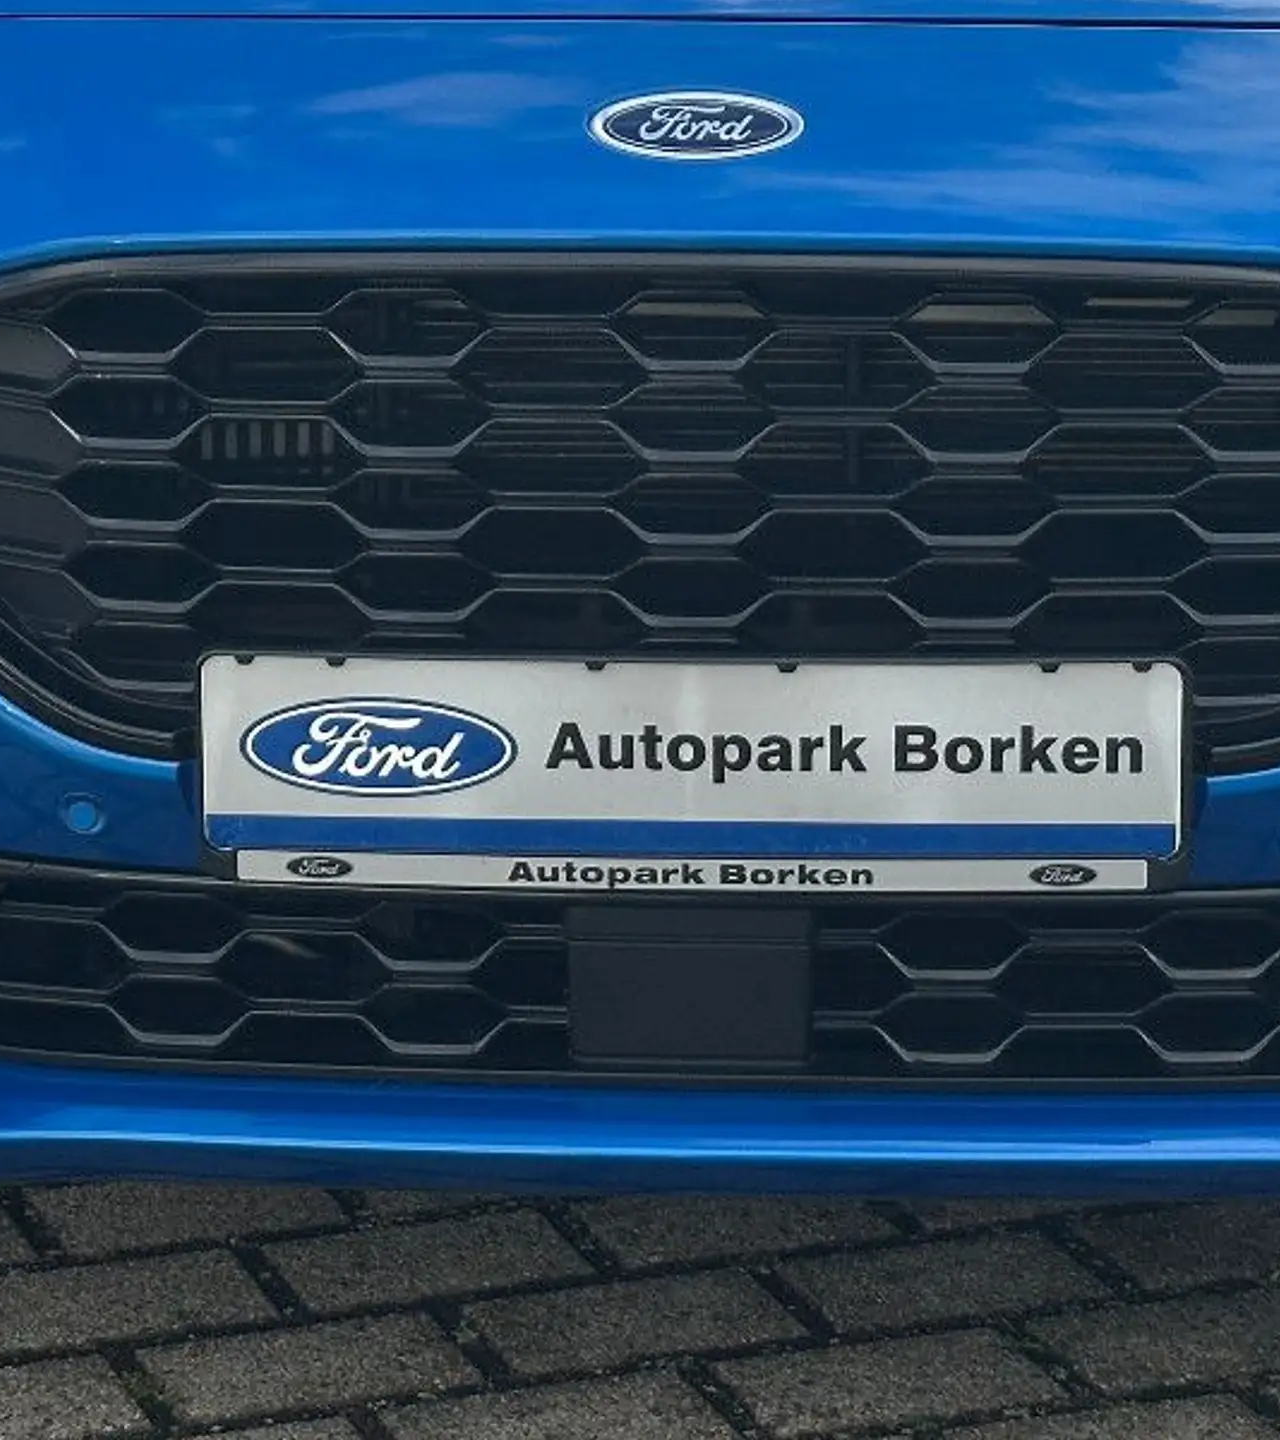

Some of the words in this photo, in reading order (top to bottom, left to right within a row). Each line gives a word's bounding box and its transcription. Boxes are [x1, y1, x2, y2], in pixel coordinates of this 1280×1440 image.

[639, 105, 754, 141] Ford
[292, 711, 465, 779] Ford
[545, 722, 868, 784] Autopark
[894, 724, 1144, 775] Borken
[508, 860, 705, 889] Autopark
[719, 863, 874, 886] Borken
